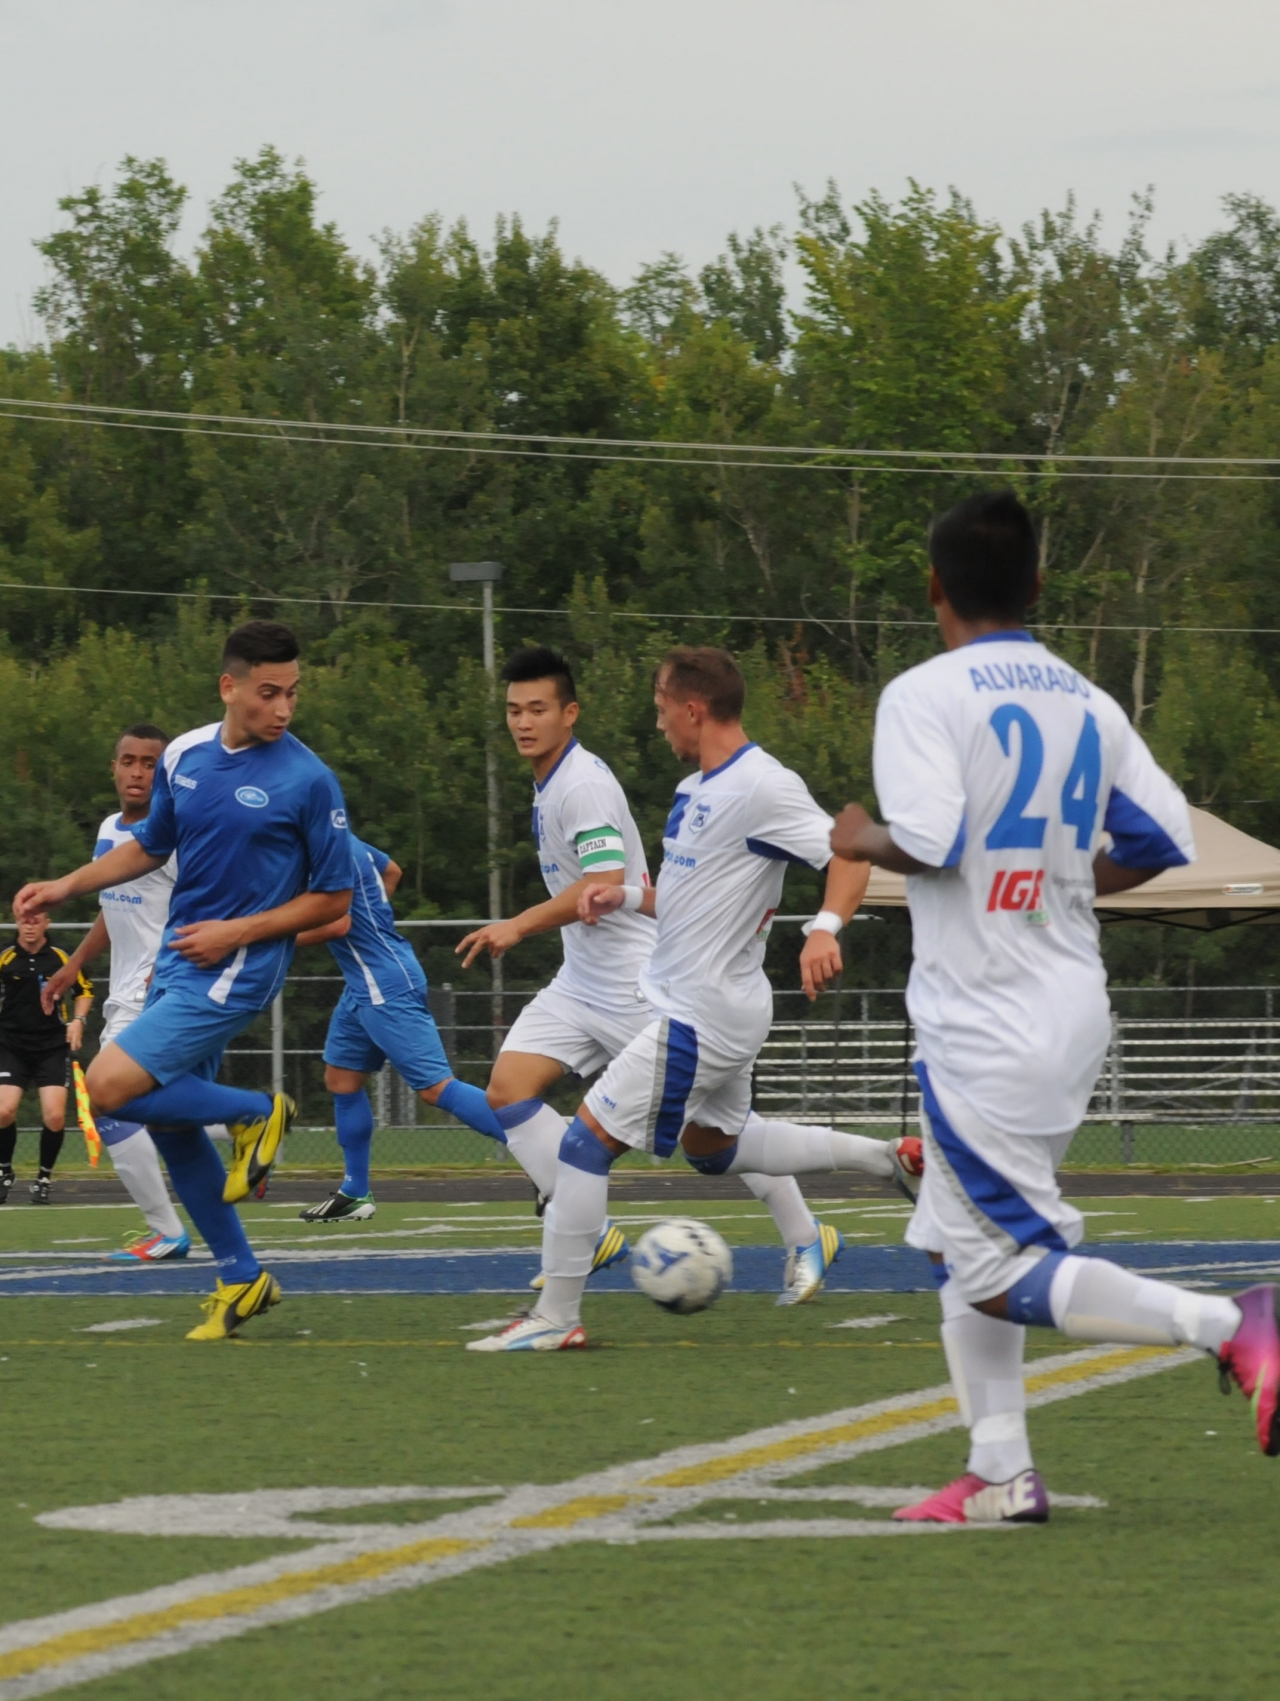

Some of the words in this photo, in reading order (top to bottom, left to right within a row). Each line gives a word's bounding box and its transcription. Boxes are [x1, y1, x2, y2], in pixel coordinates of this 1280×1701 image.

[969, 663, 1091, 699] ALVARADO
[985, 703, 1101, 851] 24
[580, 838, 607, 855] CAPTAIN
